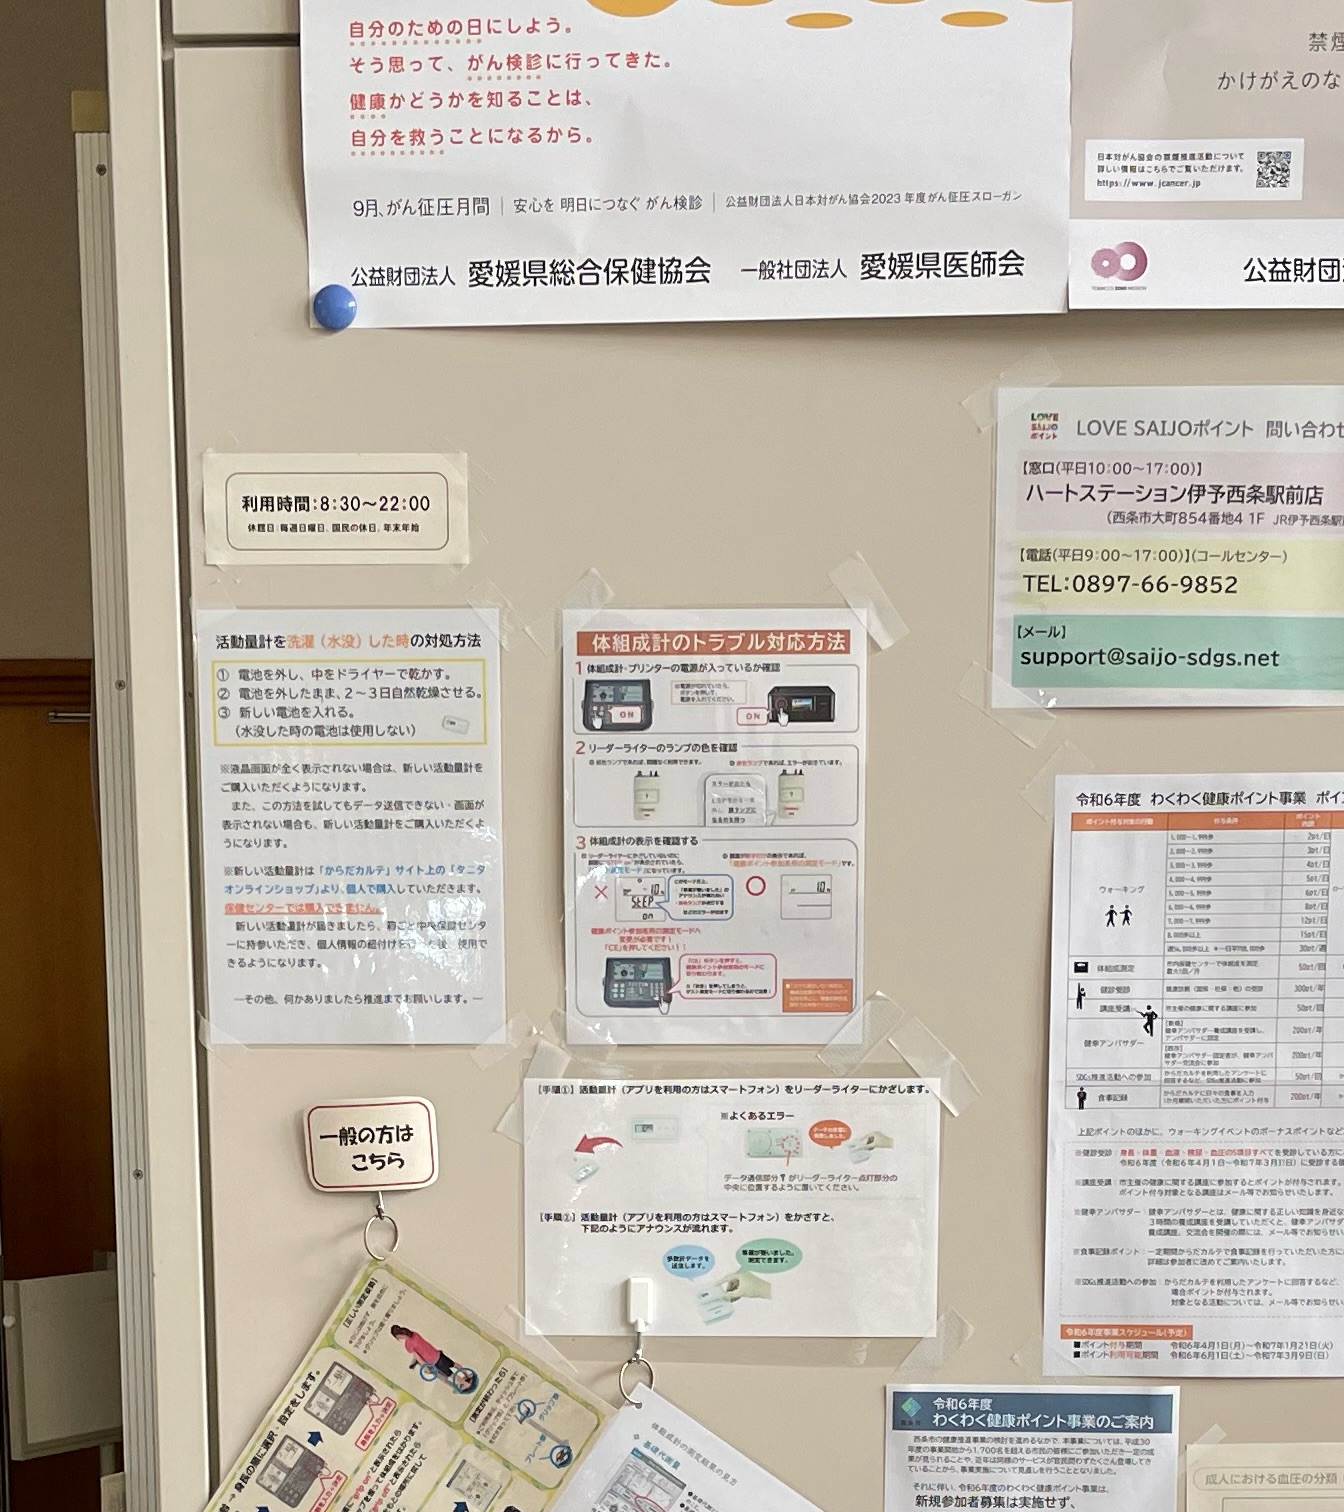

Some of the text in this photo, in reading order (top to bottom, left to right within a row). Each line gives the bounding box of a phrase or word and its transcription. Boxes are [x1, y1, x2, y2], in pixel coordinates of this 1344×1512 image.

[350, 18, 574, 38] 自分のための日にしよう。
[350, 51, 674, 74] そう思って、がん検診に行ってきた。
[350, 89, 593, 113] 健康かどうかを知ることは、
[351, 125, 595, 149] 自分を救うことになるから。
[1097, 179, 1201, 188] https://www.jcancer.jp
[645, 194, 703, 212] がん検診
[351, 256, 712, 288] 公益財団法人 愛媛県総合保健協会
[741, 249, 1025, 282] 一般社団法人 愛媛県医師会
[1076, 420, 1127, 437] LOVE
[1133, 419, 1254, 438] SAIJOポイント
[1026, 483, 1324, 506] ハートステーション伊予西条駅前店
[1249, 511, 1265, 525] 1F
[1023, 574, 1238, 595] TEL:0897-66-9852
[216, 633, 482, 650] 活動量計を洗濯（水没）した時の対処方法
[592, 632, 846, 653] 体組成計のトラブル対応方法
[1020, 647, 1280, 668] support@saijo-sdgs.net
[238, 668, 451, 681] 電池を外し、中をドライヤーで乾かす。
[575, 662, 582, 674] 1
[239, 706, 354, 719] 新しい電池を入れる。
[620, 710, 634, 719] ON
[746, 712, 761, 720] ON
[575, 741, 585, 754] 2
[1076, 792, 1141, 807] 令和6年度
[1151, 791, 1307, 806] わくわく健康ポイント事業
[224, 838, 288, 849] うになります。
[576, 836, 586, 849] 3
[1099, 885, 1145, 895] ウォーキング
[320, 1124, 414, 1146] 一般の方は
[352, 1152, 405, 1171] こちら
[933, 1398, 993, 1411] 令和6年度
[933, 1414, 1154, 1429] わくわく健康ポイント事業のご案内
[1206, 1472, 1338, 1485] 成人における血圧の分類
[915, 1495, 1076, 1509] 新規参加者募集は実施せず、
